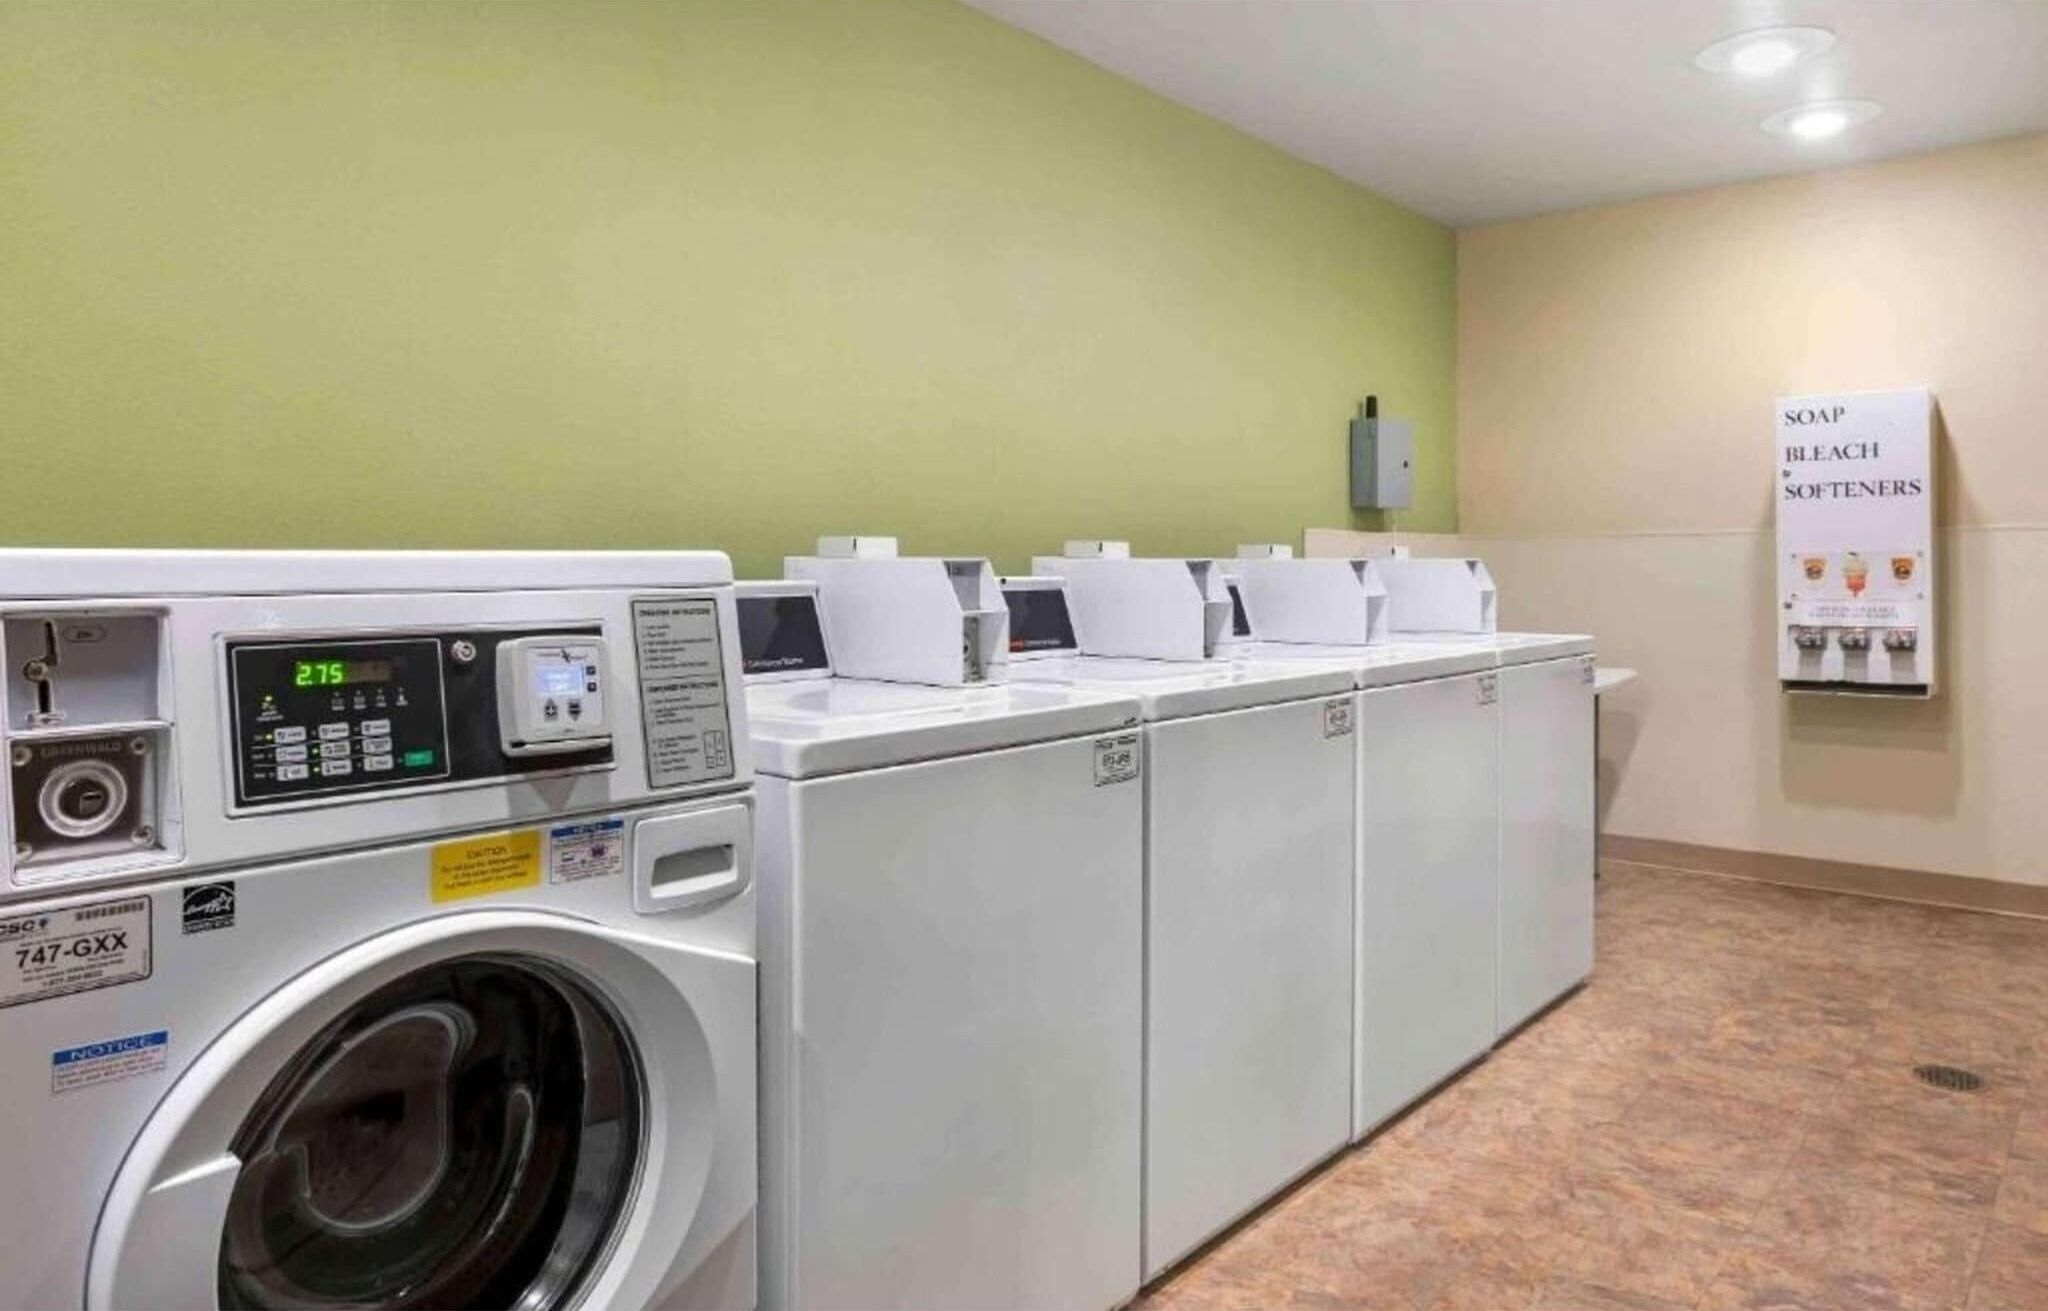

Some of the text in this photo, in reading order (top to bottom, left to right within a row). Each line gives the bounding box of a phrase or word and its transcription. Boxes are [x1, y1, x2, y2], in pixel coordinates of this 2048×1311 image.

[1785, 406, 1844, 426] SOAP
[1786, 442, 1878, 462] BLEACH
[1785, 479, 1921, 499] SOFTENERS
[296, 663, 343, 685] 2.75
[16, 931, 127, 968] 747-GXX
[71, 1037, 151, 1060] NOTICE
